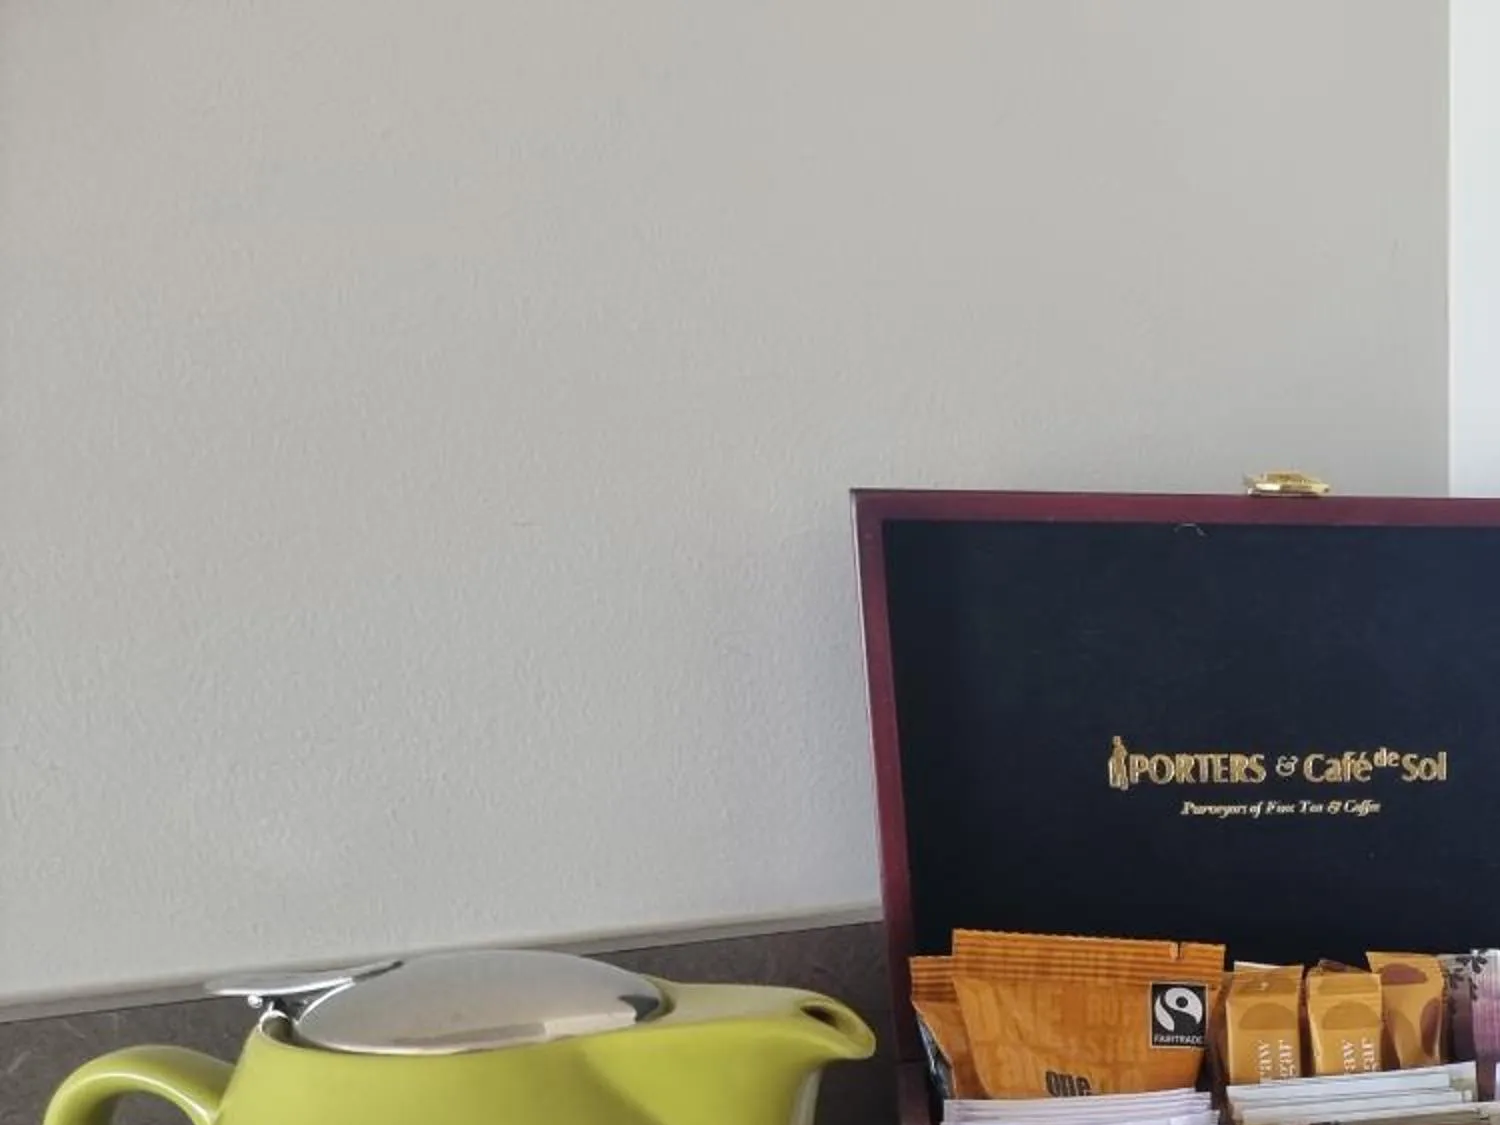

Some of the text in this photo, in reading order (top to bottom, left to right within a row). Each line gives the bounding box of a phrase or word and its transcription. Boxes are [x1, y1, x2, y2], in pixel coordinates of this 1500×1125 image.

[1129, 747, 1447, 784] PORTERS & Café de Sol
[1249, 801, 1264, 818] of
